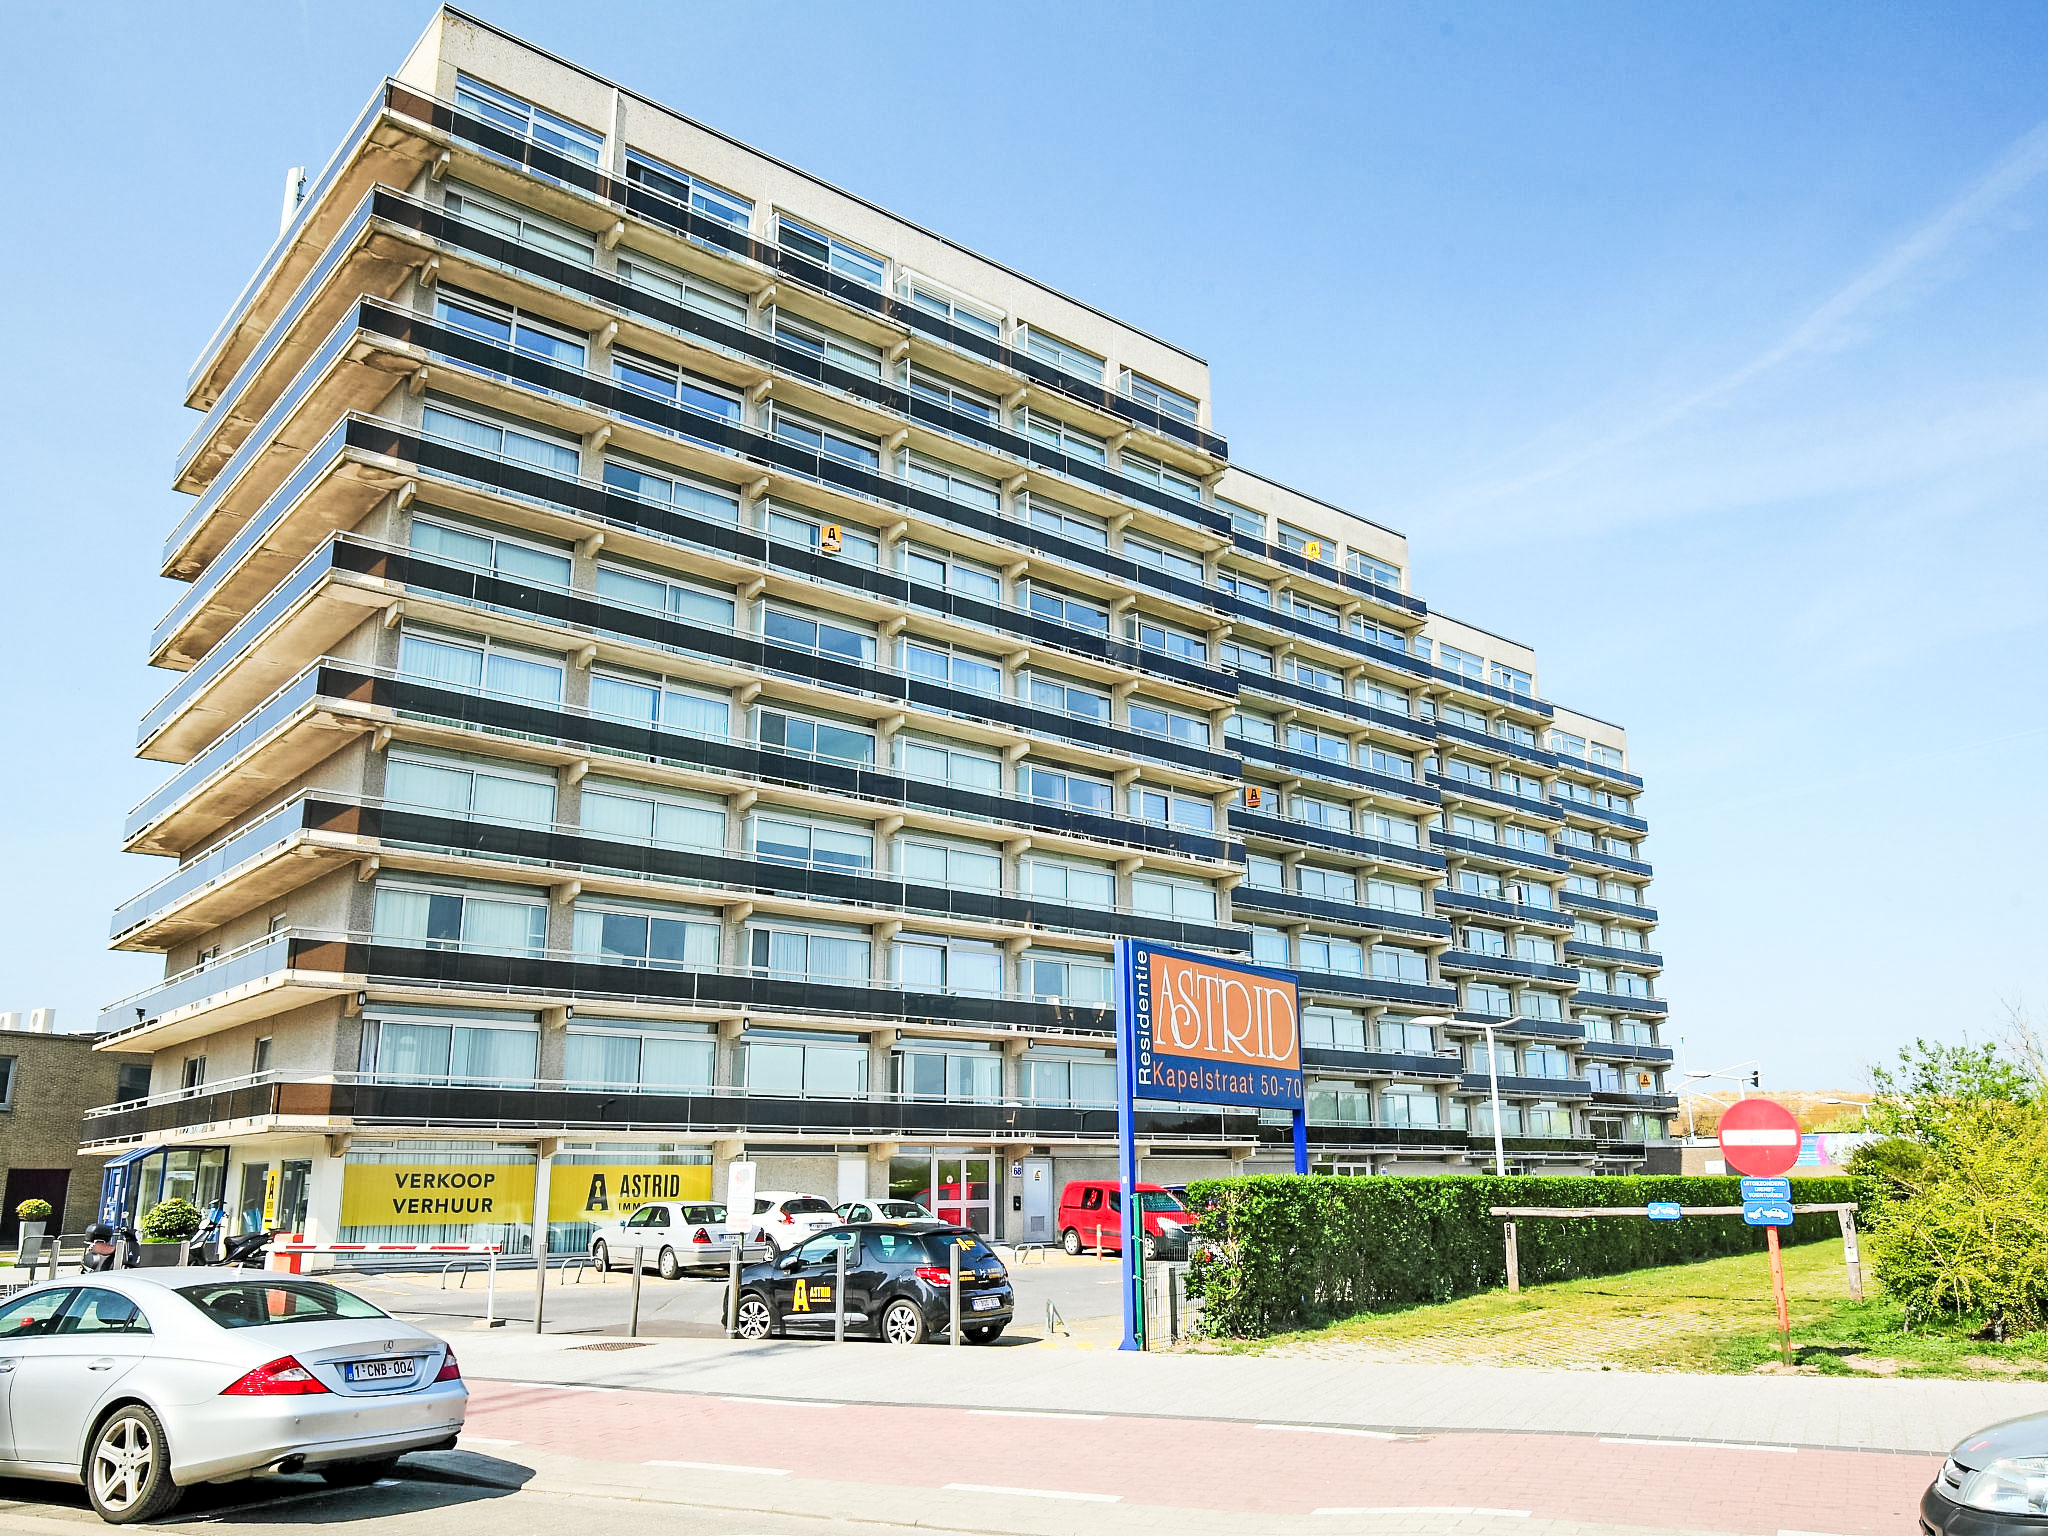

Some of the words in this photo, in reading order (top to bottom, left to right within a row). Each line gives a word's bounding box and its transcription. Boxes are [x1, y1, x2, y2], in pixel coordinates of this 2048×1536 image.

[1135, 950, 1151, 1085] Residentie
[1154, 962, 1296, 1062] ASTRID
[1152, 1060, 1254, 1094] Kapelstraat
[1260, 1075, 1301, 1099] 50-70
[395, 1173, 496, 1190] VERKOOP
[1013, 1166, 1022, 1176] 68
[392, 1197, 494, 1214] VERHUUR
[584, 1173, 609, 1211] A
[619, 1174, 680, 1198] ASTRID
[792, 1278, 810, 1312] A
[809, 1286, 831, 1298] ASTRID
